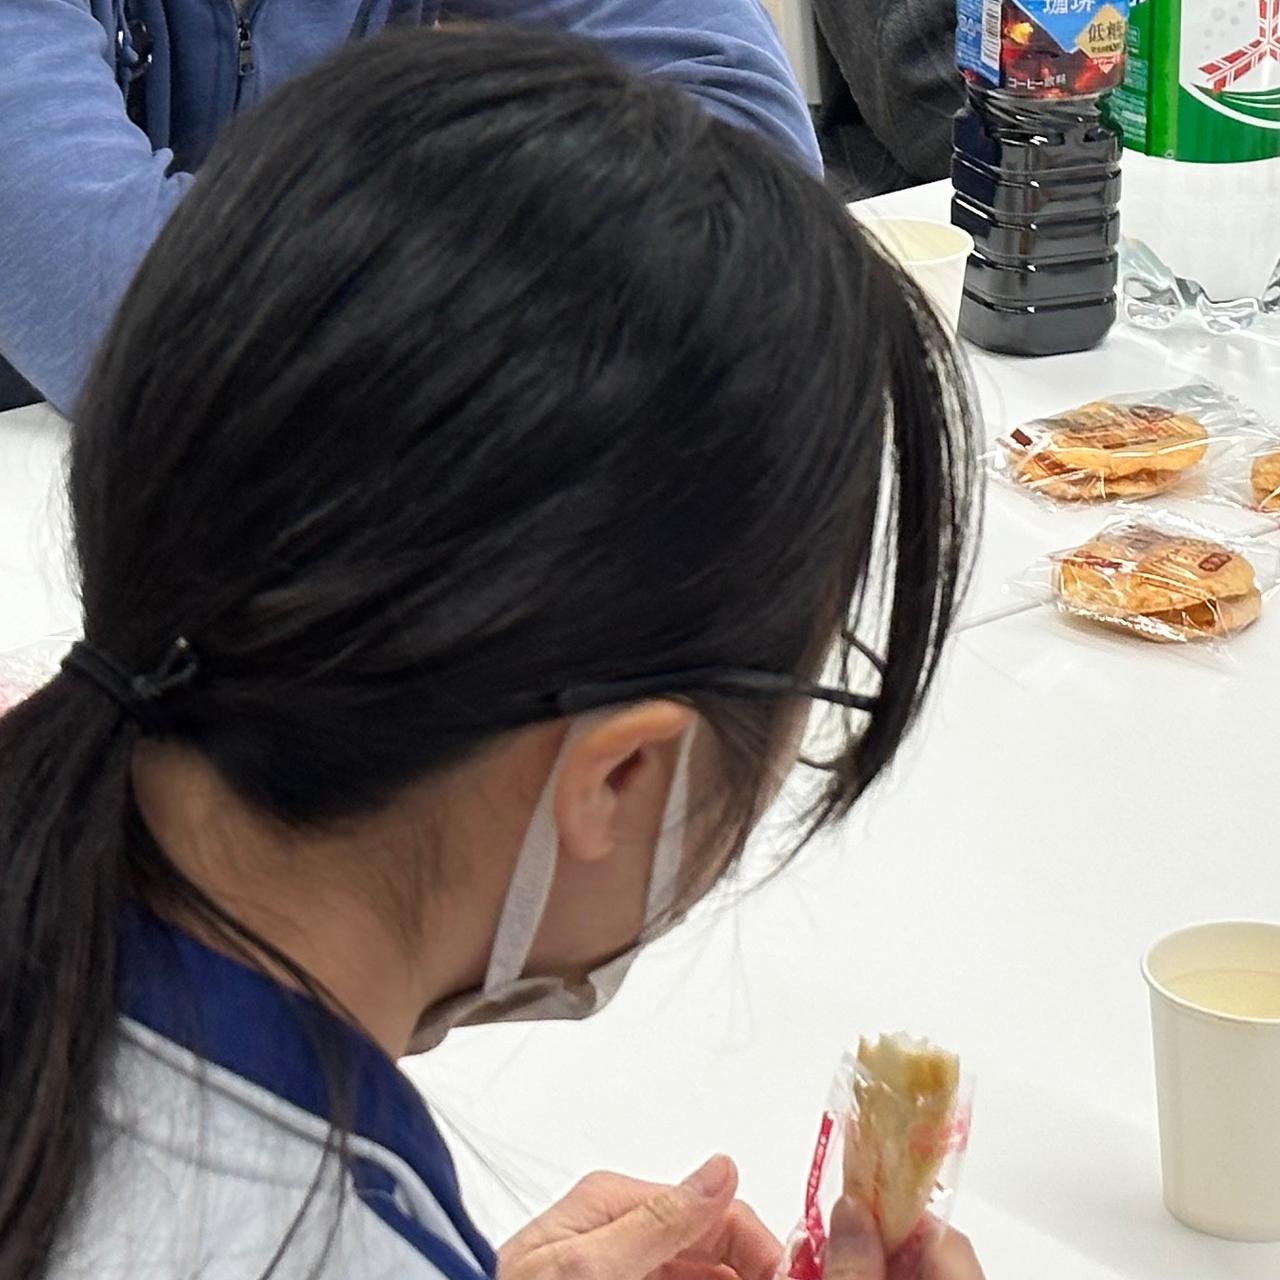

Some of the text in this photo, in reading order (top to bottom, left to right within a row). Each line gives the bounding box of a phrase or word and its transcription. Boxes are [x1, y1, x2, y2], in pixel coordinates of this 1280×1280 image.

[1007, 73, 1066, 90] コーヒー飲料
